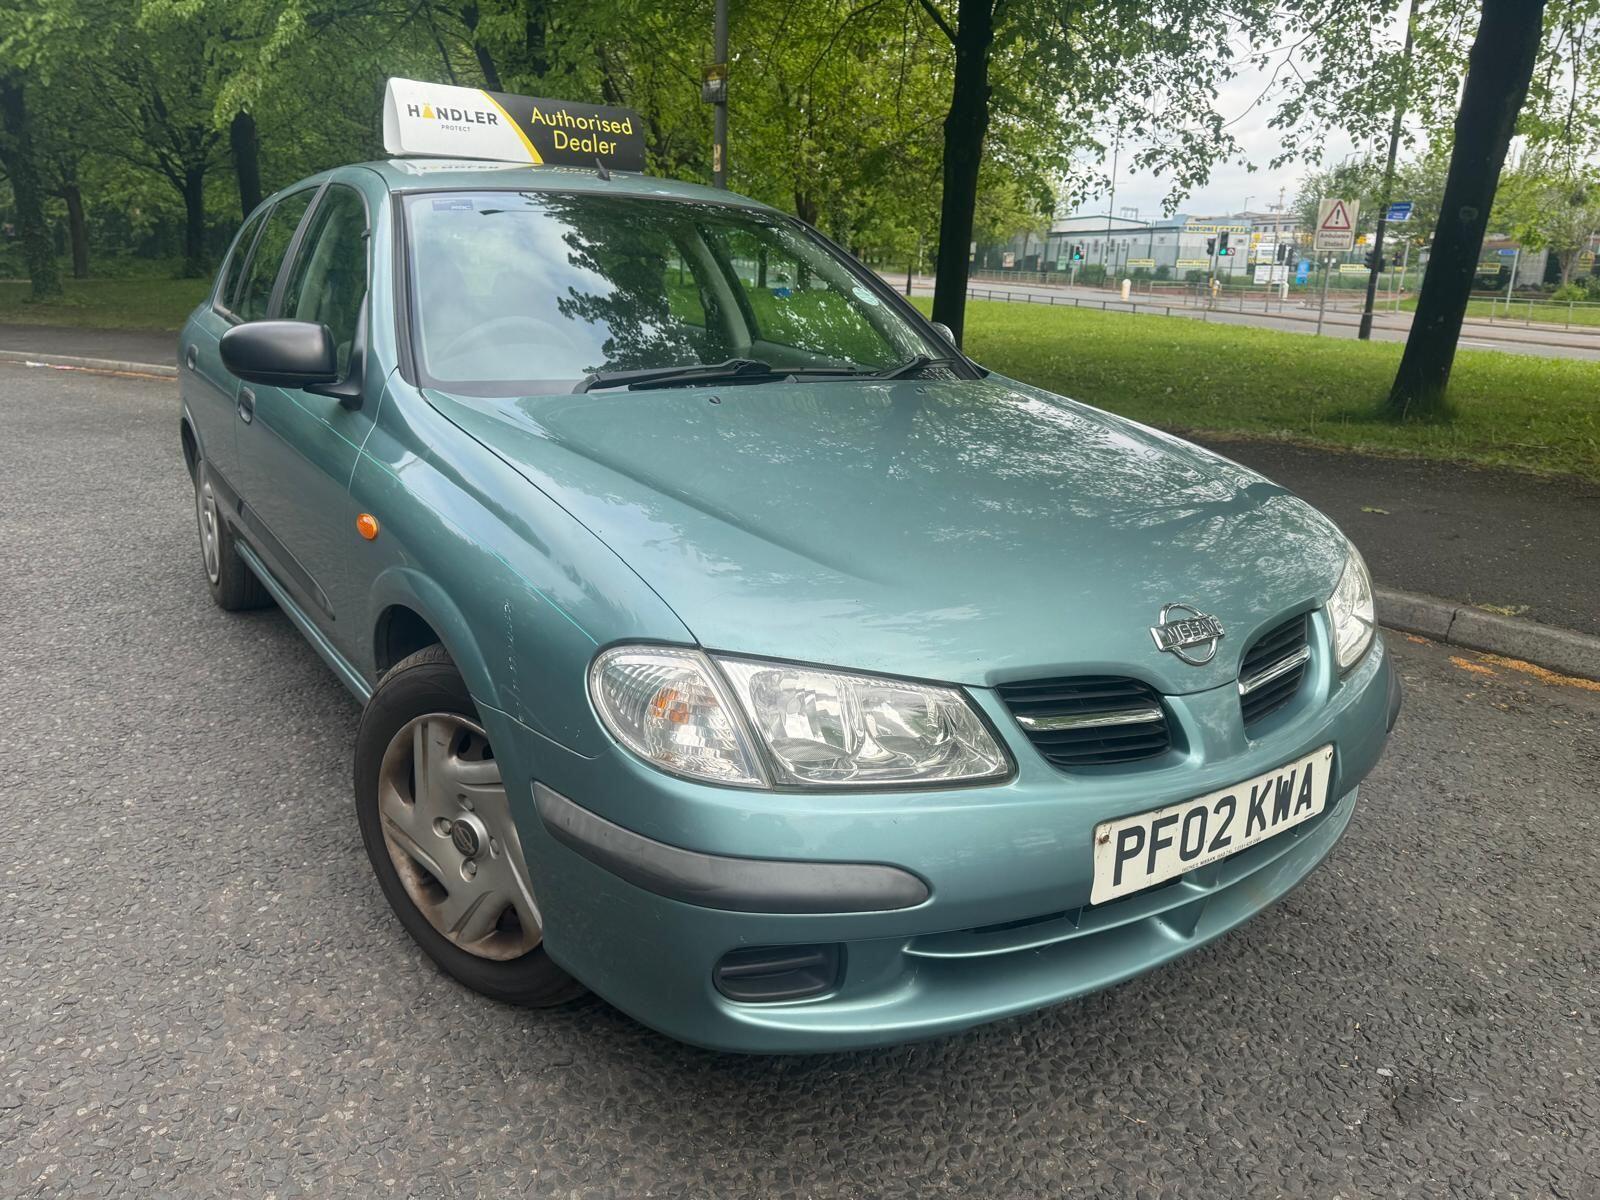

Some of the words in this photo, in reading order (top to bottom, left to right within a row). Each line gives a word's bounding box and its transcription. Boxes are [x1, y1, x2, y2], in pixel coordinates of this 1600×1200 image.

[441, 124, 471, 132] PROTECT
[531, 106, 633, 135] Authorised
[553, 130, 617, 155] Dealer
[1166, 618, 1221, 645] NISSAN
[1112, 795, 1237, 887] PF02
[1245, 762, 1313, 839] KWA
